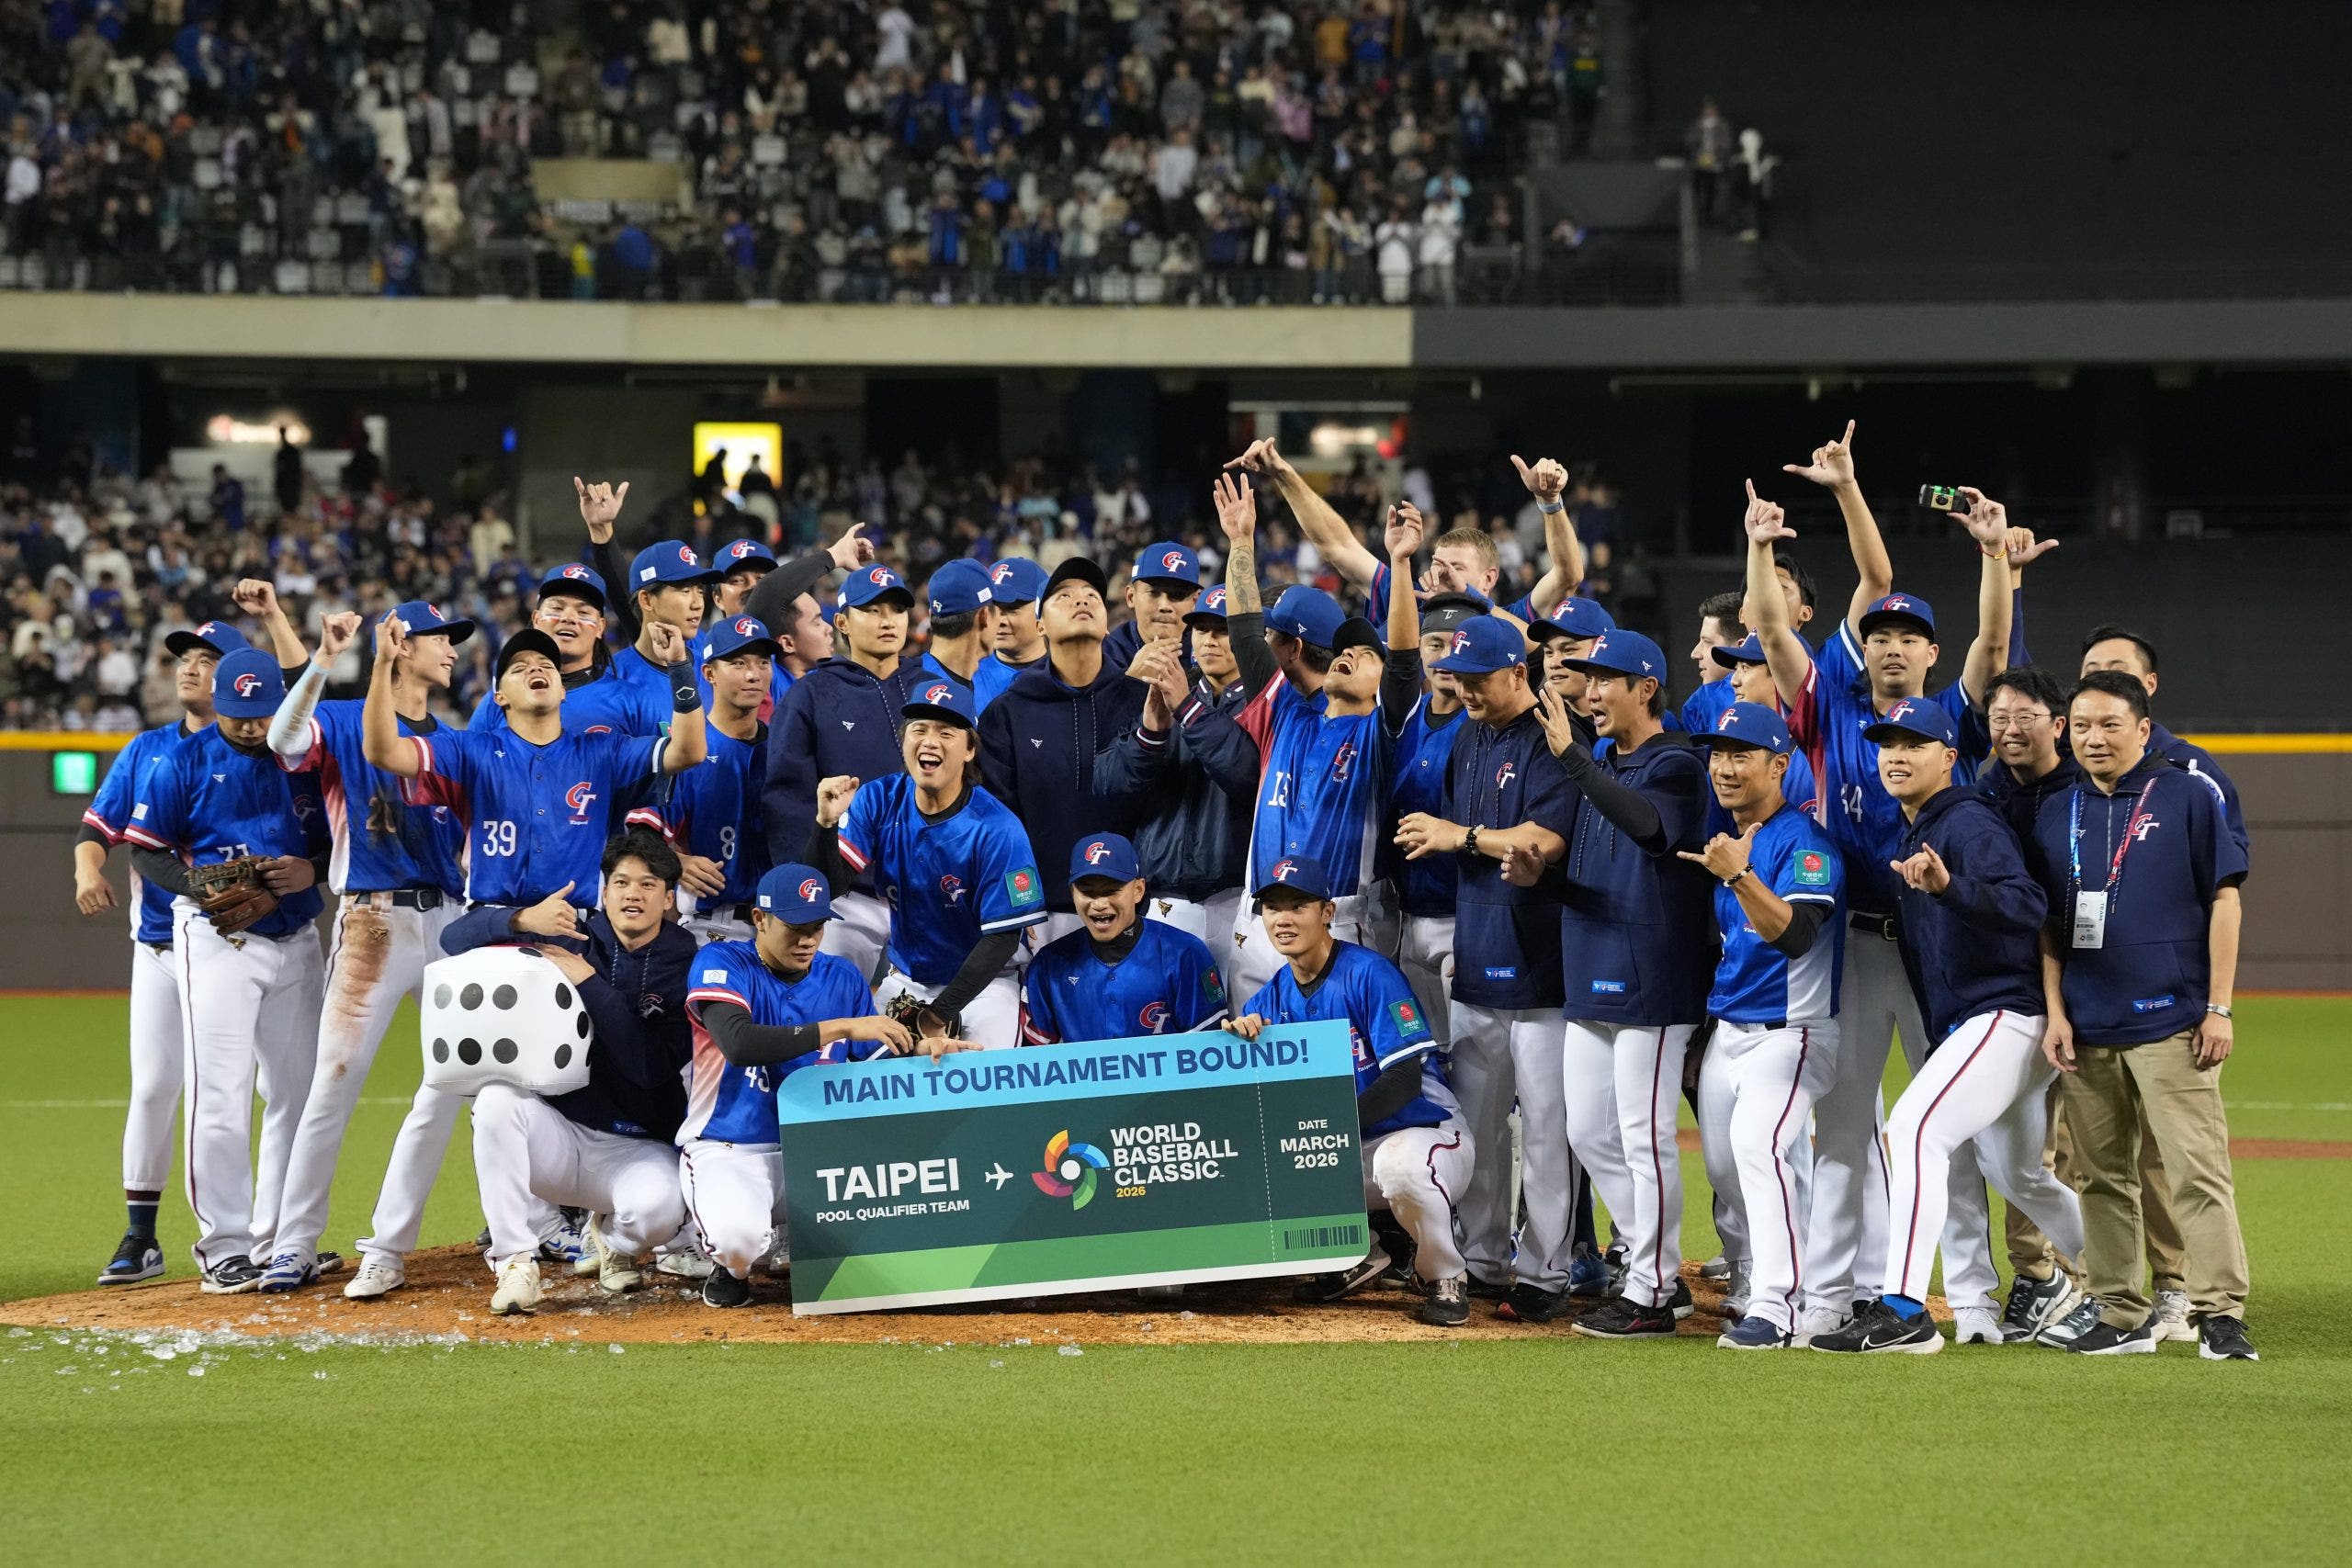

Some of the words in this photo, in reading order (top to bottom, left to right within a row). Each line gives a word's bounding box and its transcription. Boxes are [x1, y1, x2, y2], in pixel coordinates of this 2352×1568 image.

[482, 820, 516, 857] 39
[719, 826, 735, 861] 8
[823, 1073, 915, 1106] MAIN
[922, 1051, 1167, 1097] TOURNAMENT
[1175, 1038, 1309, 1076] BOUND!
[1110, 1122, 1201, 1147] WORLD
[1298, 1119, 1328, 1131] DATE
[1114, 1139, 1238, 1167] BASEBALL
[1280, 1134, 1350, 1154] MARCH
[1114, 1160, 1219, 1186] CLASSIC
[1294, 1152, 1339, 1169] 2026
[816, 1157, 959, 1202] TAIPEI
[1116, 1186, 1146, 1198] 2026
[816, 1210, 854, 1224] POOL
[856, 1203, 928, 1222] QUALIFIER
[930, 1200, 970, 1213] TEAM
